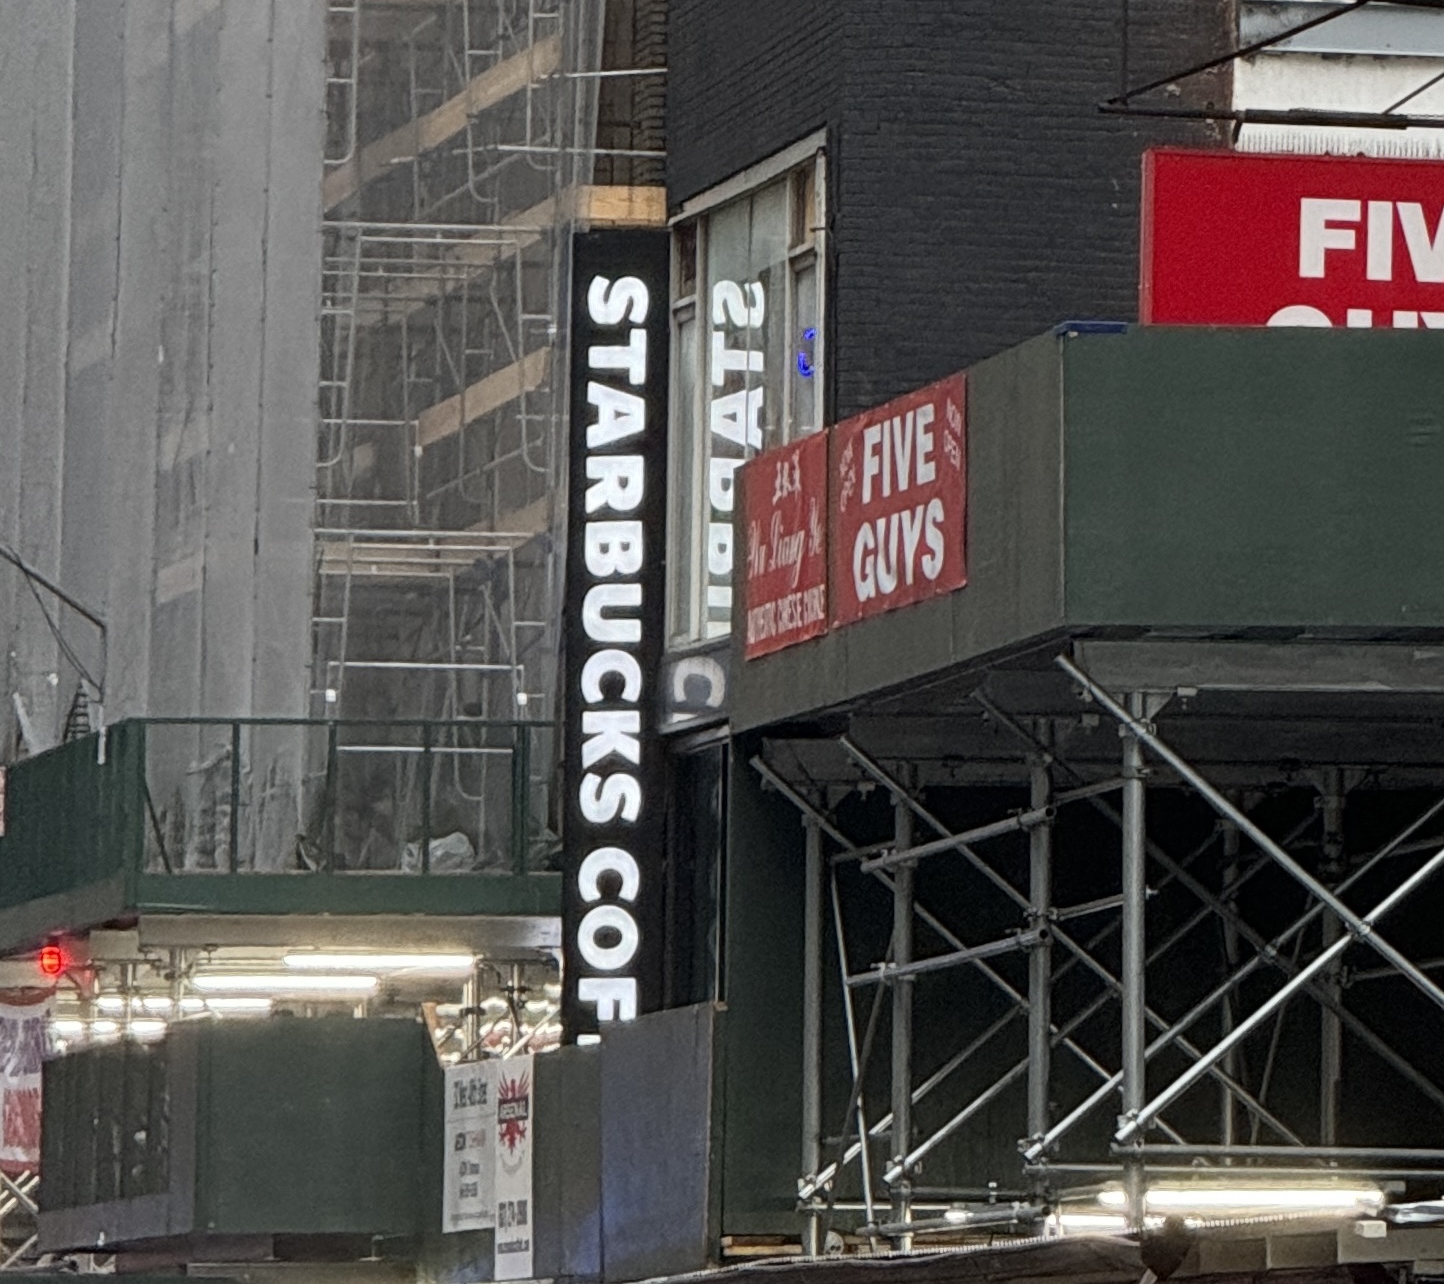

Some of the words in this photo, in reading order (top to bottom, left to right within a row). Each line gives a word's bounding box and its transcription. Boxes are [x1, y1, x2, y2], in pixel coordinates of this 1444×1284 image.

[861, 403, 937, 506] FIVE
[579, 274, 650, 825] STARBUCKS
[852, 497, 945, 603] GUYS
[577, 845, 640, 1046] COF
